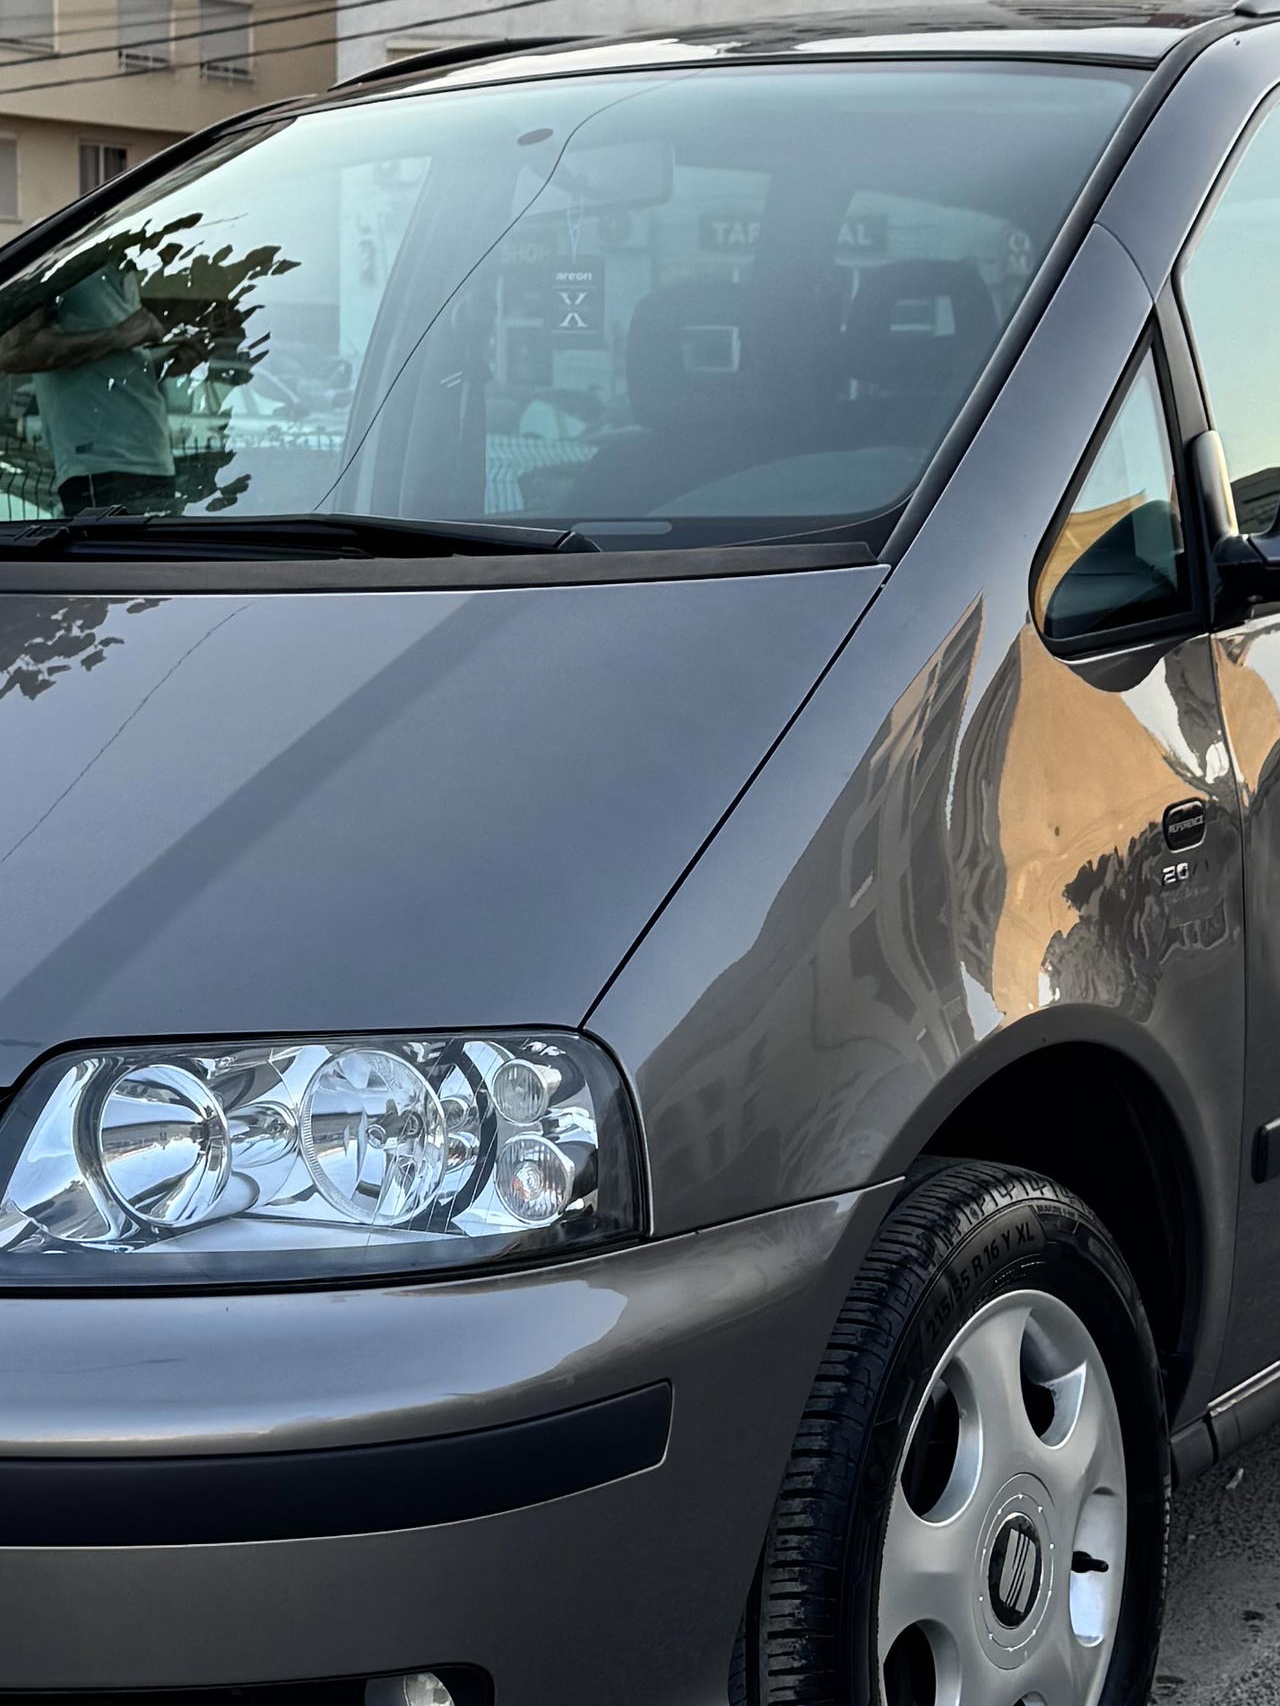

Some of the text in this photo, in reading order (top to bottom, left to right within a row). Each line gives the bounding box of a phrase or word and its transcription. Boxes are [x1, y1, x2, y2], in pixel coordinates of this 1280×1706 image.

[925, 1268, 971, 1342] 215/55
[971, 1254, 984, 1278] R
[983, 1238, 1001, 1266] 16
[1001, 1228, 1012, 1251] Y
[1015, 1222, 1036, 1246] XL
